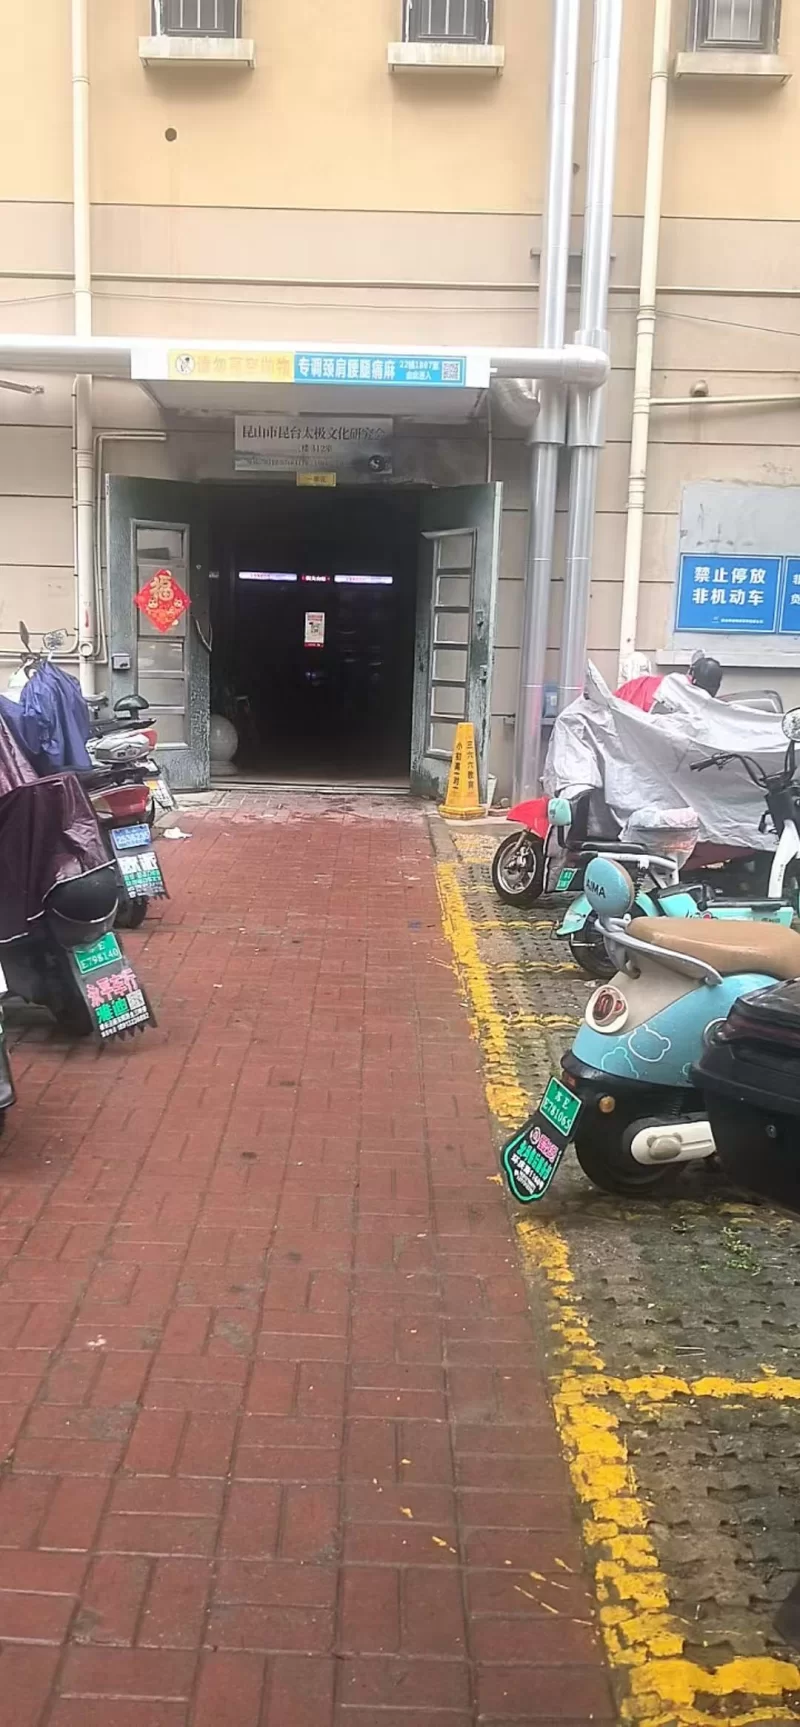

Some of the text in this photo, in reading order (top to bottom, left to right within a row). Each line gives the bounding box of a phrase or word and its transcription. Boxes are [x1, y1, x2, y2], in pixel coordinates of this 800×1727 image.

[694, 566, 767, 584] 禁止停放
[150, 575, 174, 601] 福
[692, 587, 764, 606] 非机动车
[586, 878, 606, 899] AIMA
[543, 1098, 572, 1129] E781065
